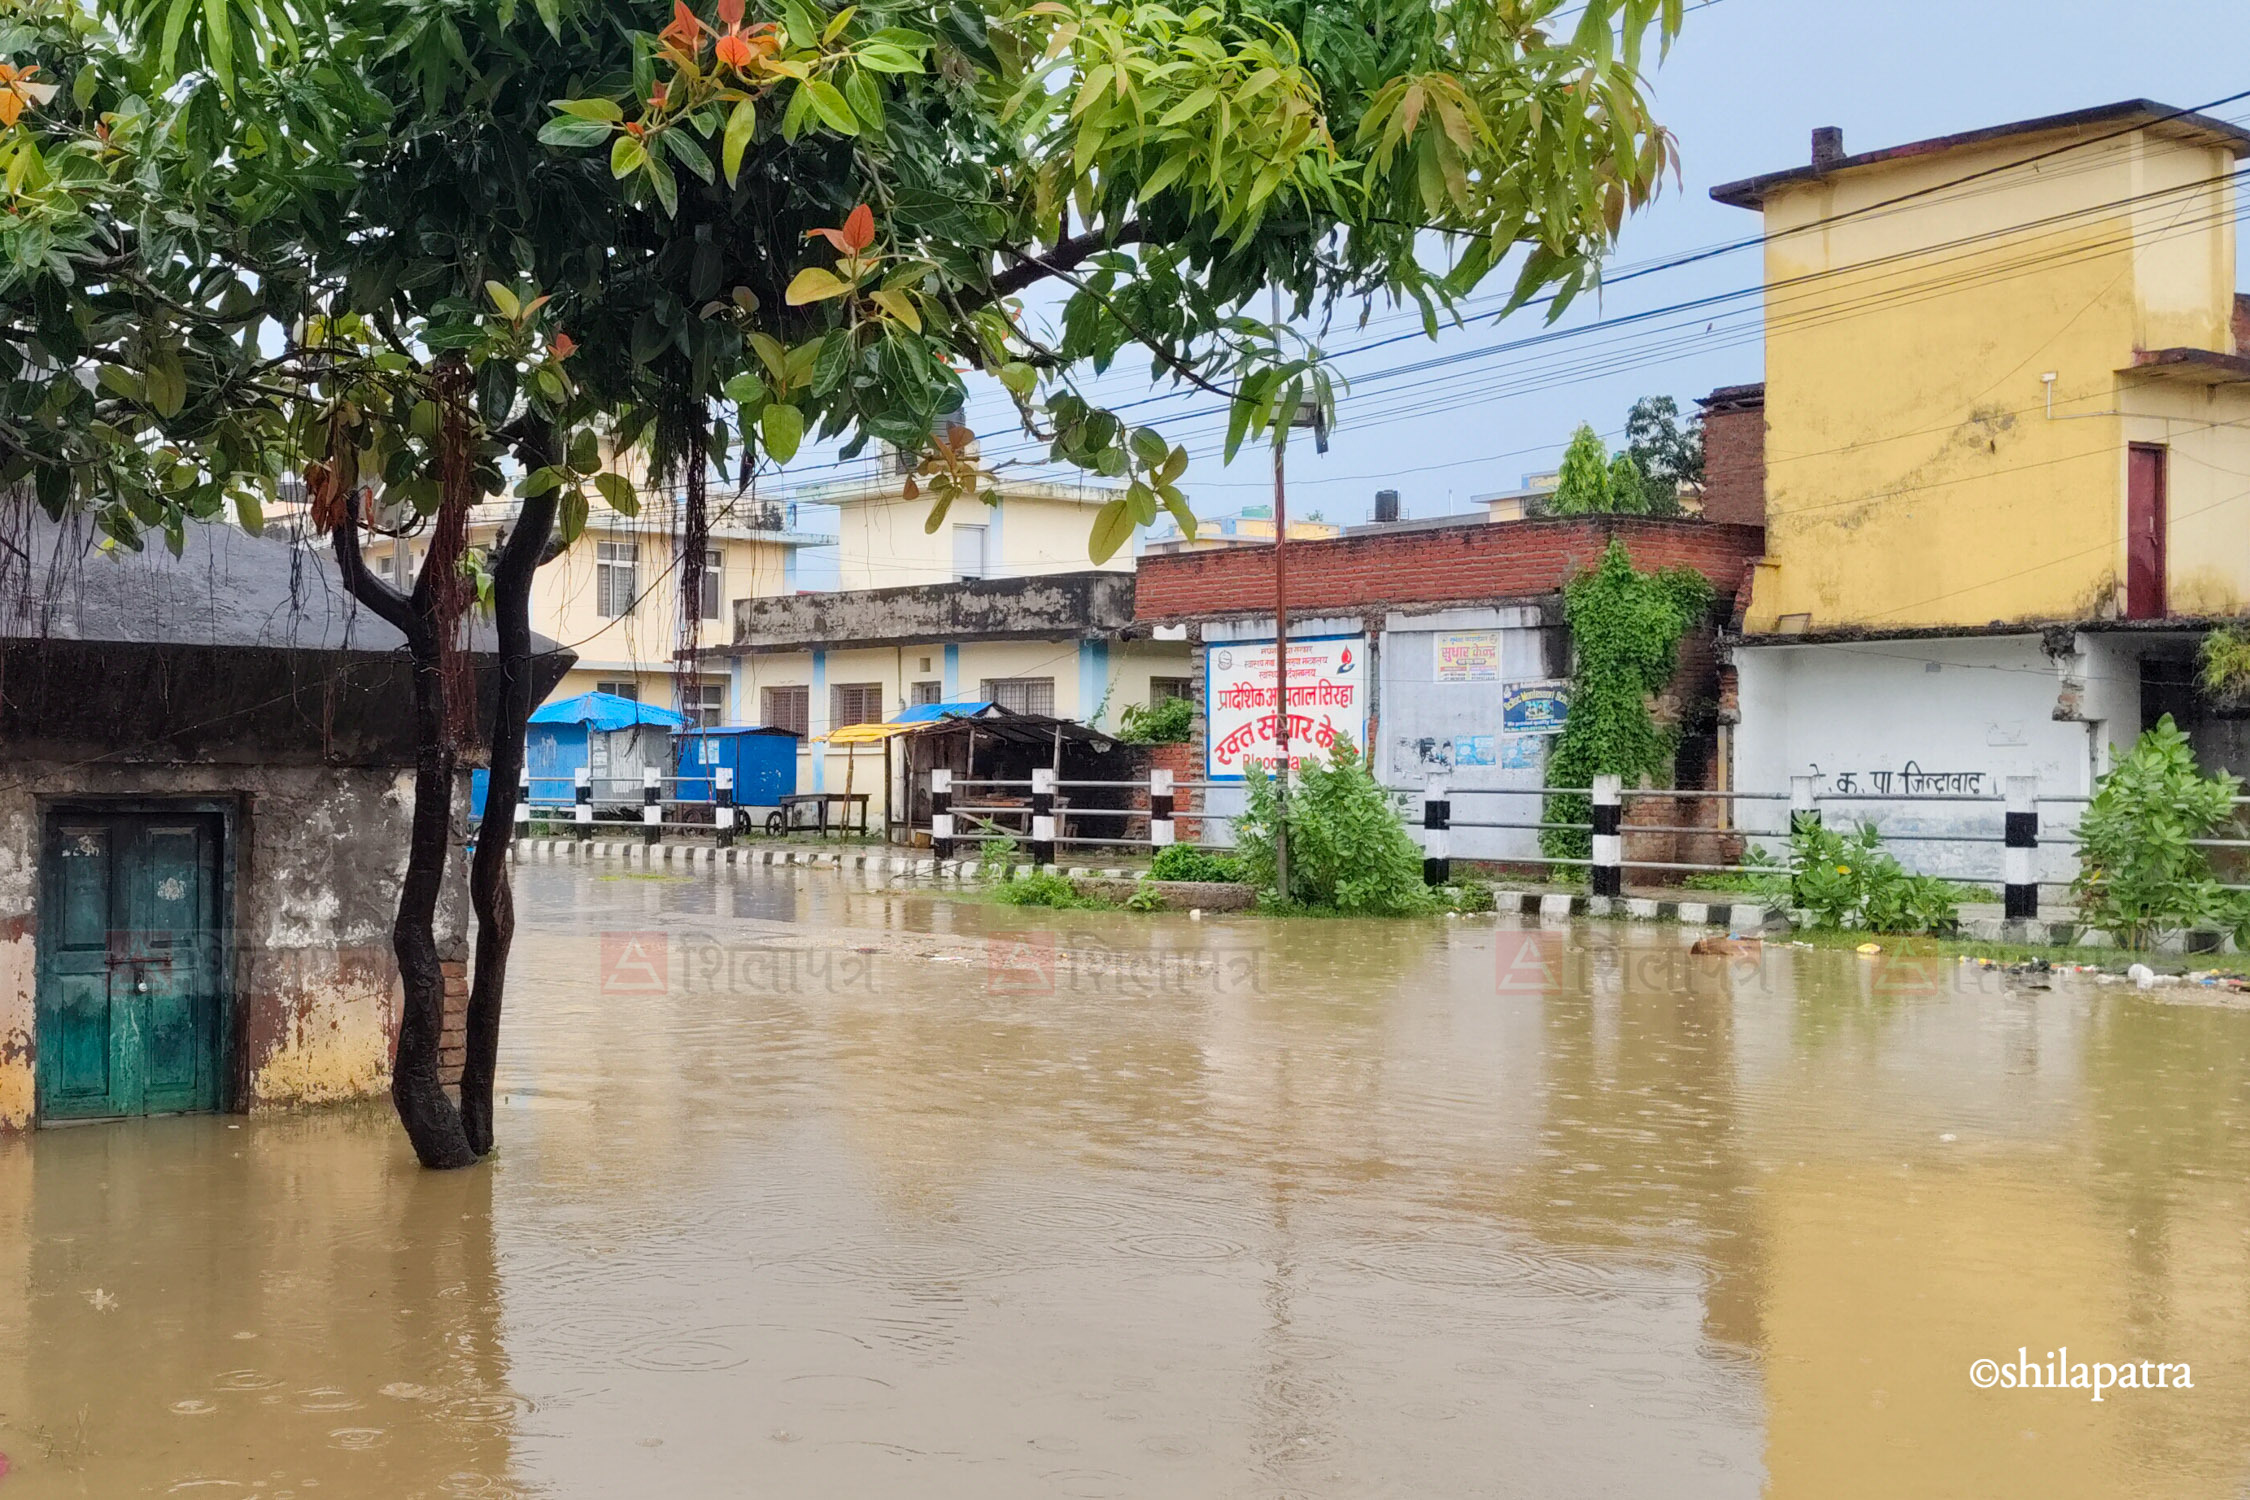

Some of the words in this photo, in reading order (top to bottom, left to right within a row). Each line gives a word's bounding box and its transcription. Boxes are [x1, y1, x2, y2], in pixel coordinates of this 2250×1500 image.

[1440, 647, 1470, 663] सुधार
[1471, 643, 1497, 659] केन्द्र
[1286, 668, 1316, 680] र्देशनालय
[1217, 681, 1265, 711] प्रादेशिक
[1266, 685, 1316, 708] अपताल
[1318, 678, 1354, 709] सिरहा
[1520, 688, 1555, 702] Montessori
[1214, 721, 1255, 765] रक्त
